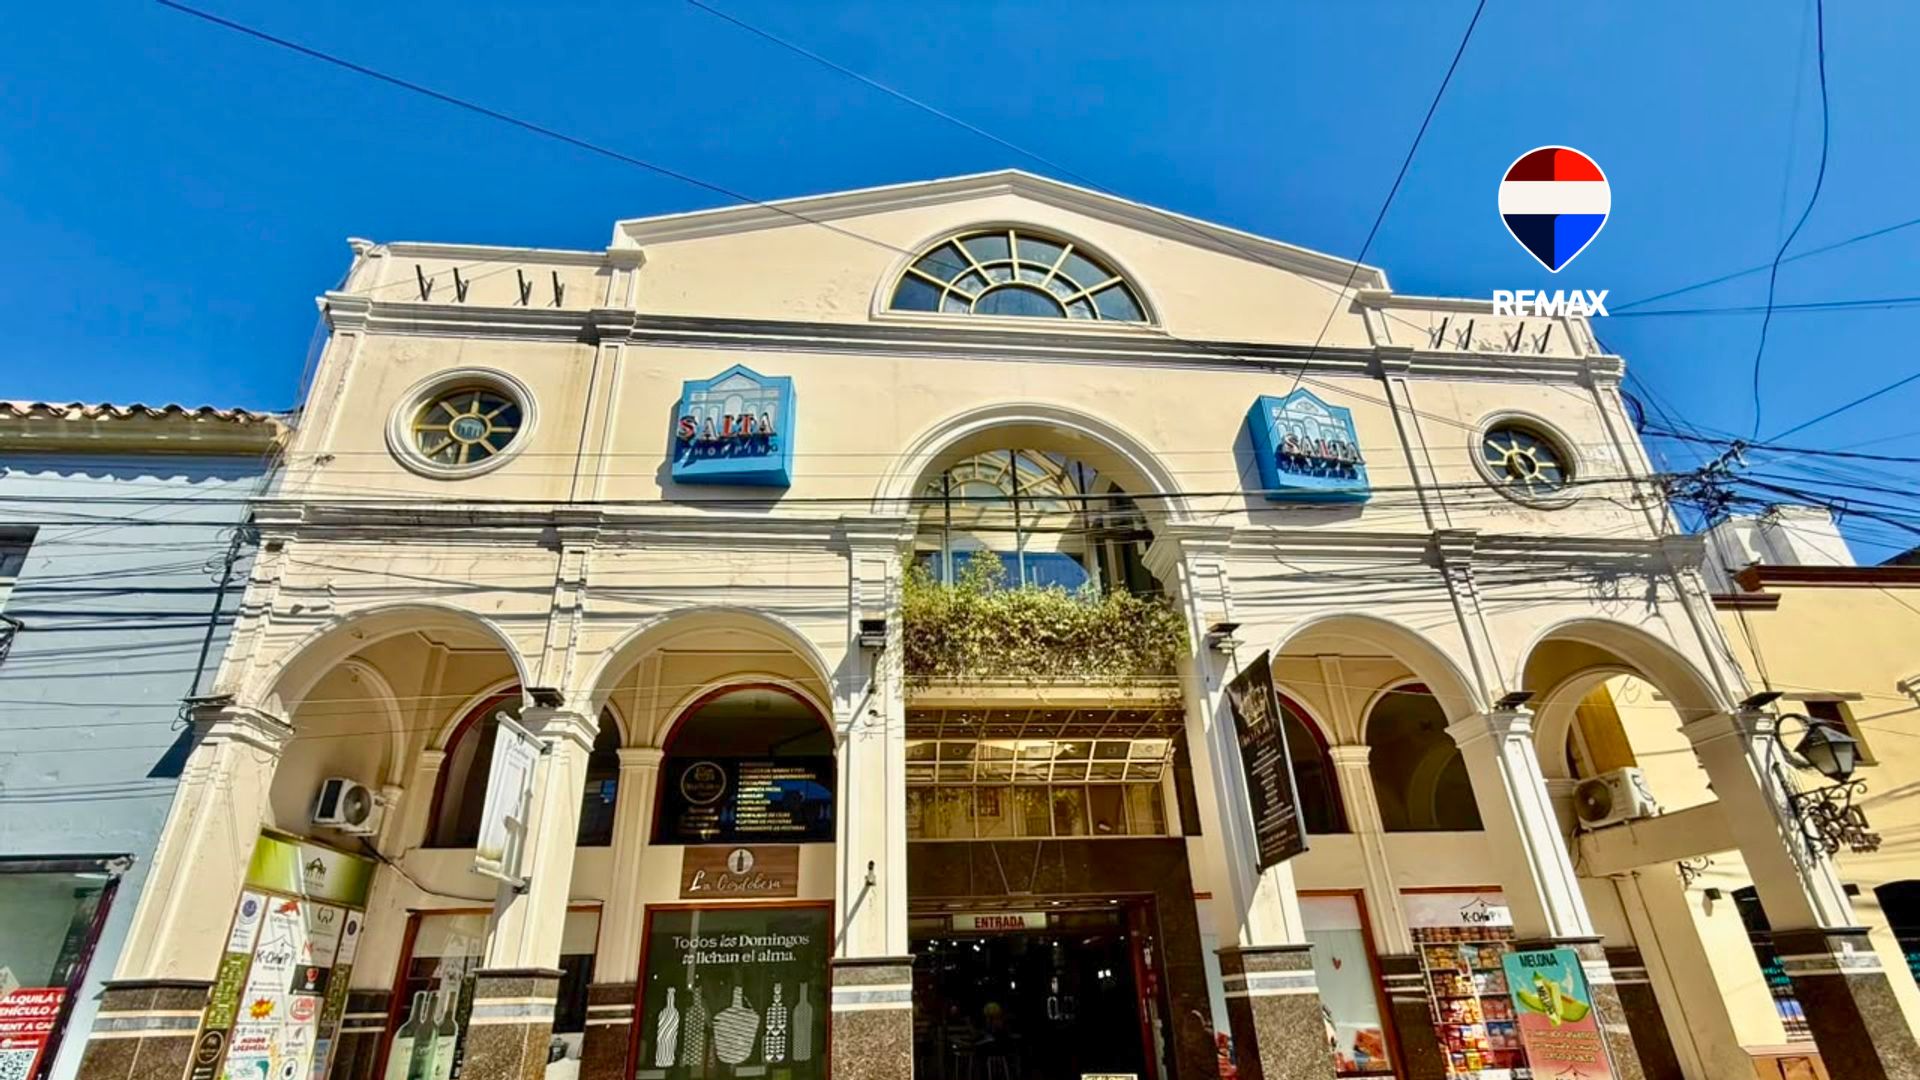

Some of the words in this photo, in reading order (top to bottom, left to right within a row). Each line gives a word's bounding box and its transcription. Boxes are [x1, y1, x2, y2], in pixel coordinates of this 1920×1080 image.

[677, 411, 777, 442] SALTA
[1282, 431, 1366, 465] SALTA
[689, 870, 711, 892] La
[717, 873, 780, 892] Cordobesa
[975, 915, 1025, 929] ENTRADA
[672, 935, 718, 949] Todos
[739, 933, 810, 949] Domingos
[741, 949, 756, 963] el
[757, 949, 797, 962] alma.
[1518, 952, 1559, 968] MELONA
[2, 992, 54, 1005] ALQUILÁ
